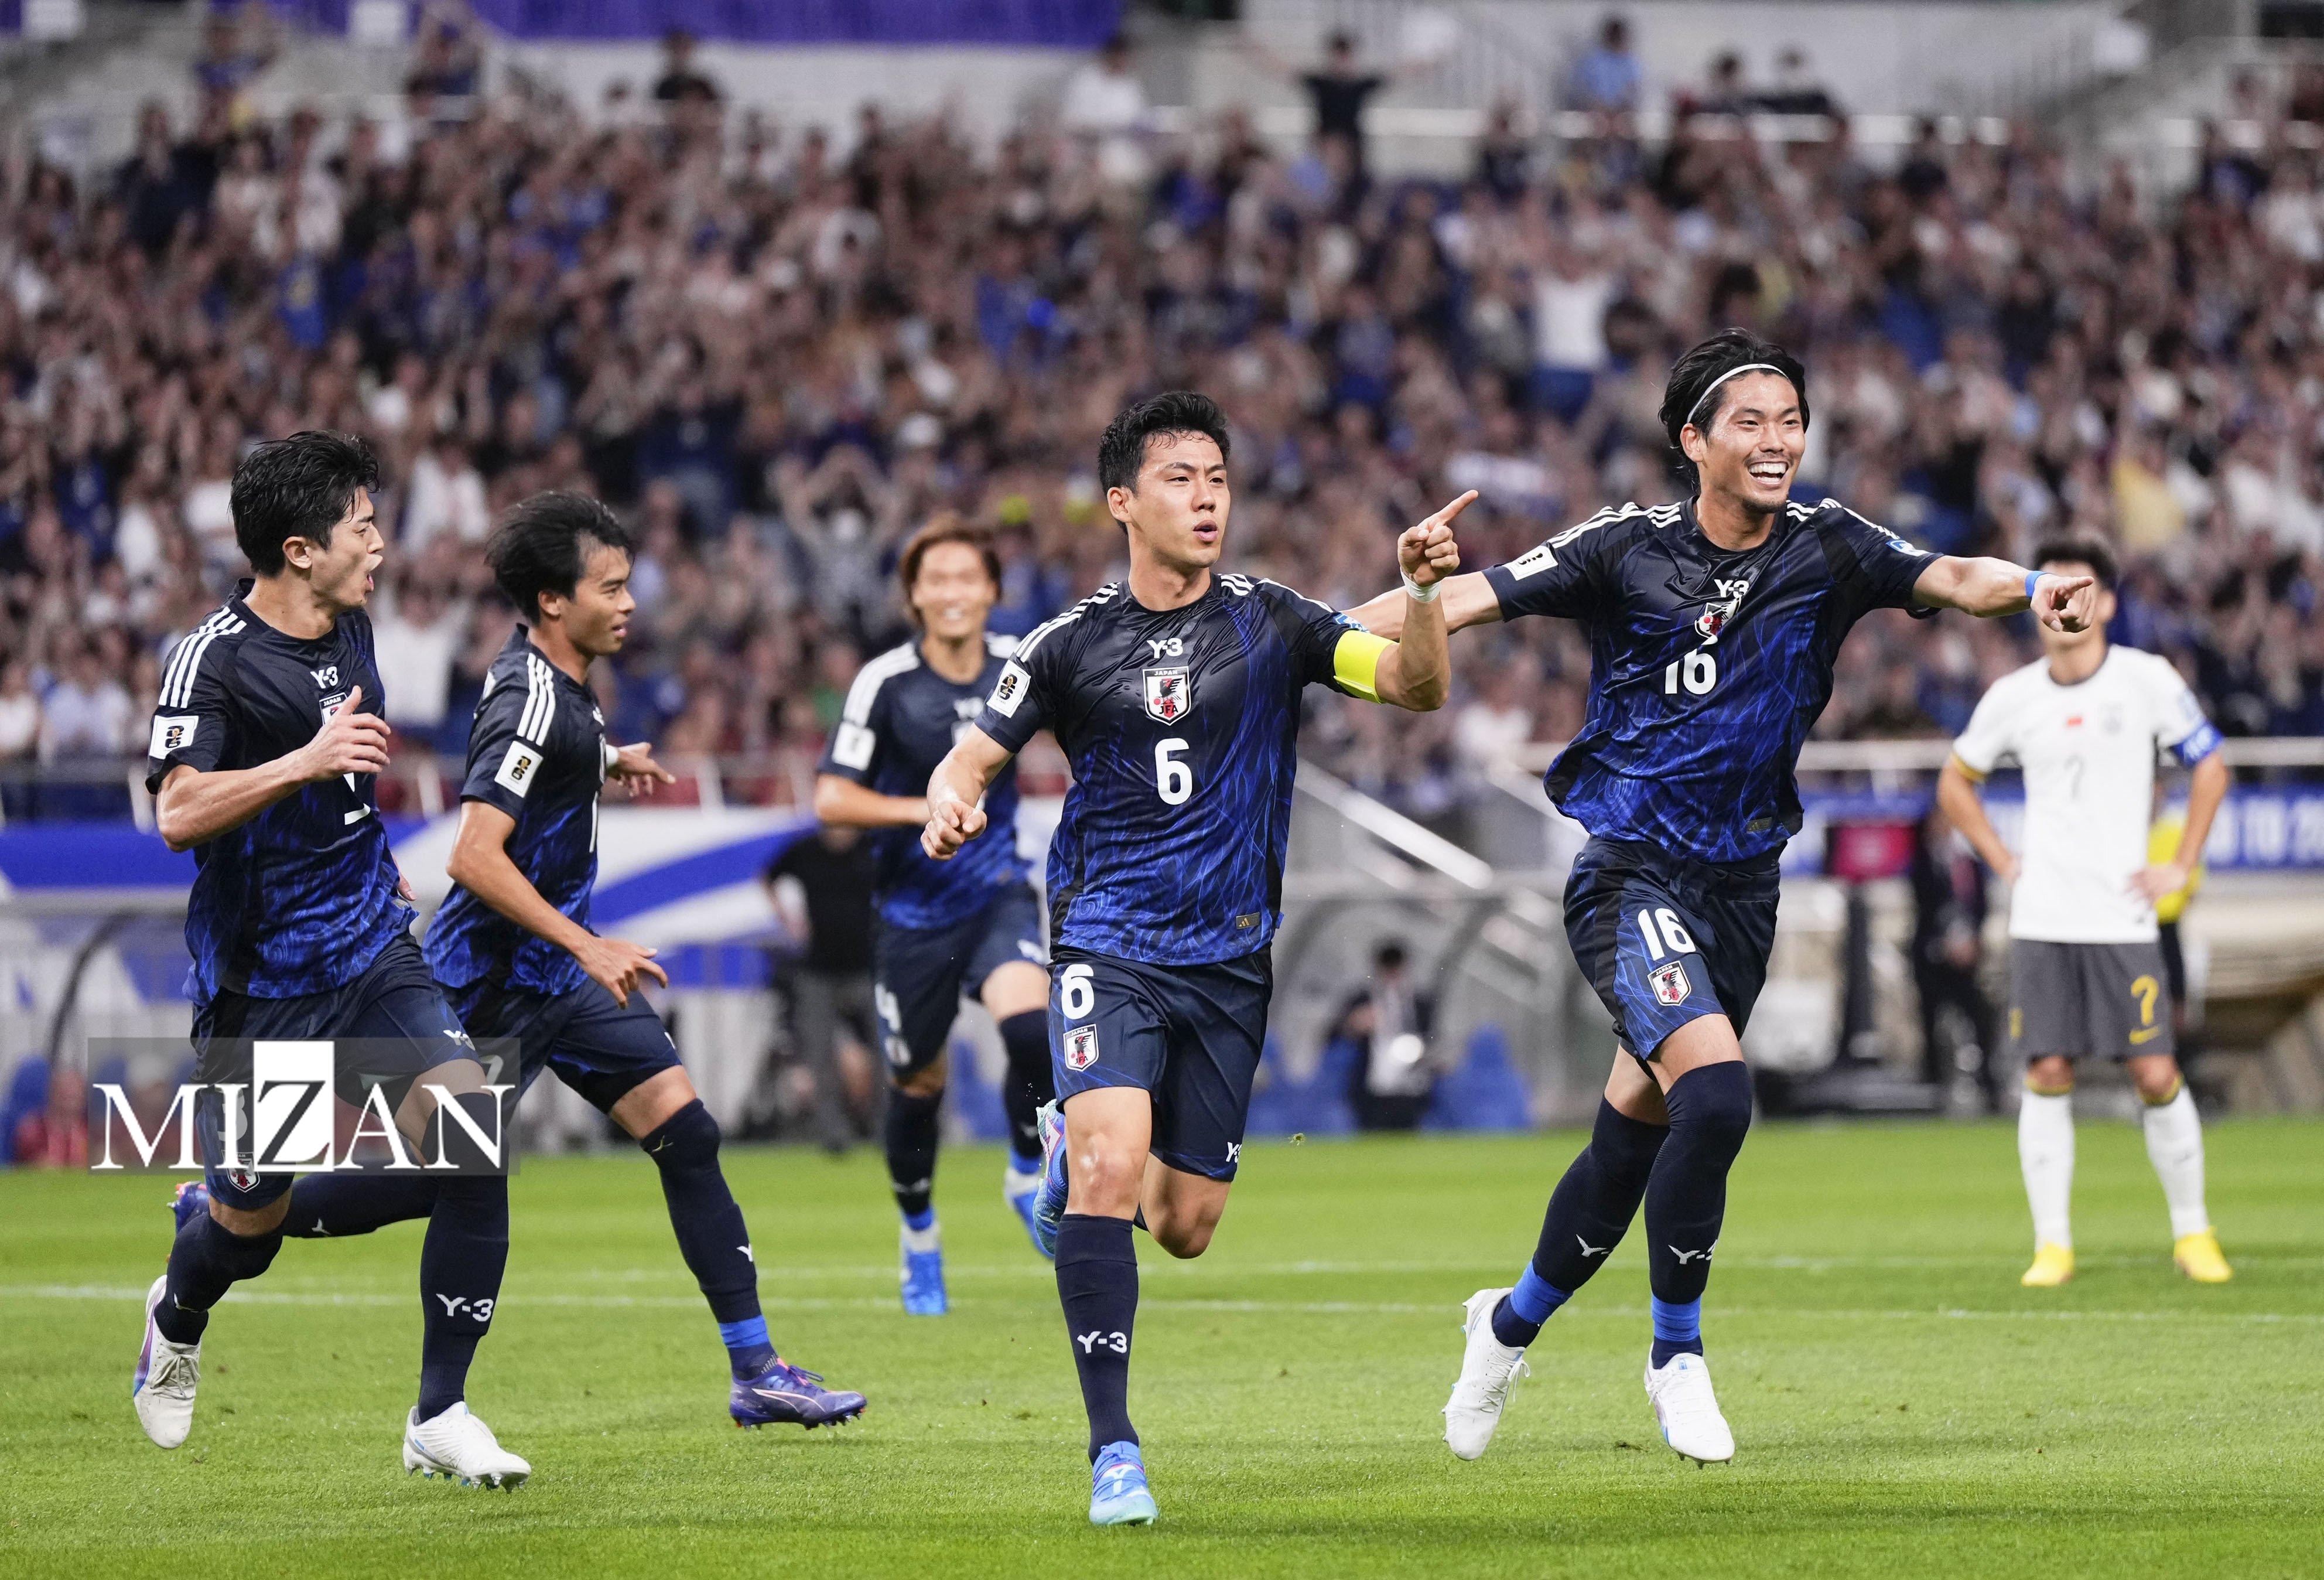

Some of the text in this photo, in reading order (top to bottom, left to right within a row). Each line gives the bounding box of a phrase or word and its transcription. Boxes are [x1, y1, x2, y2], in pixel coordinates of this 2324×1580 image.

[1714, 579, 1749, 598] Y-3
[1147, 637, 1183, 658] Y-3
[310, 666, 339, 689] Y-3
[1665, 649, 1717, 695] 16
[324, 697, 341, 707] JAPAN
[1158, 705, 1179, 714] JFA
[1154, 738, 1192, 806] 6
[2063, 754, 2087, 800] 7
[1638, 907, 1696, 960] 16
[1656, 965, 1673, 975] JAPAN
[1061, 964, 1095, 1020] 6
[2130, 974, 2159, 1026] 7
[1071, 1028, 1088, 1036] JAPAN
[1075, 1056, 1088, 1064] JFA
[436, 1293, 494, 1322] Y-3
[1078, 1331, 1127, 1354] Y-3
